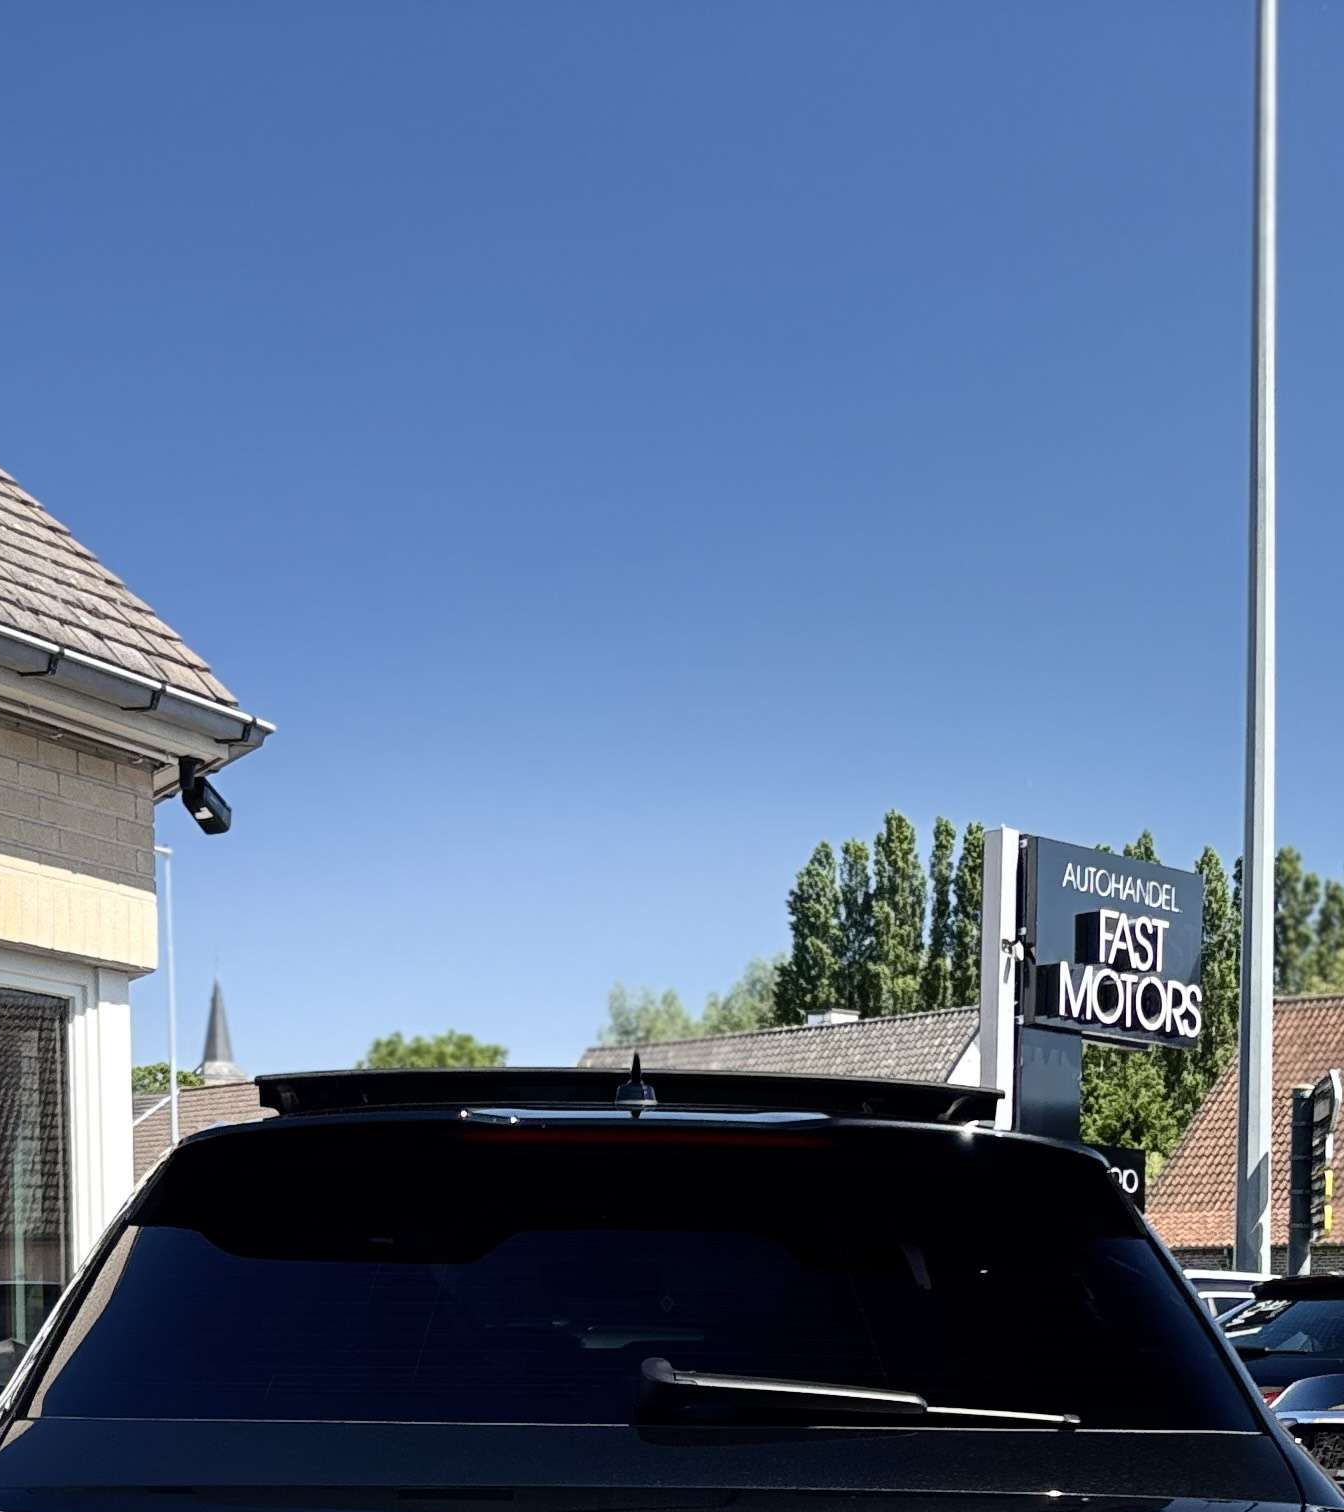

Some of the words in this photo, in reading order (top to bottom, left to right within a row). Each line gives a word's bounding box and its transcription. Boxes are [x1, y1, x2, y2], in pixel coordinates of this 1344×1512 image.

[1062, 862, 1181, 912] AUTOHANDEL
[1098, 908, 1170, 973] FAST
[1058, 960, 1203, 1038] MOTORS
